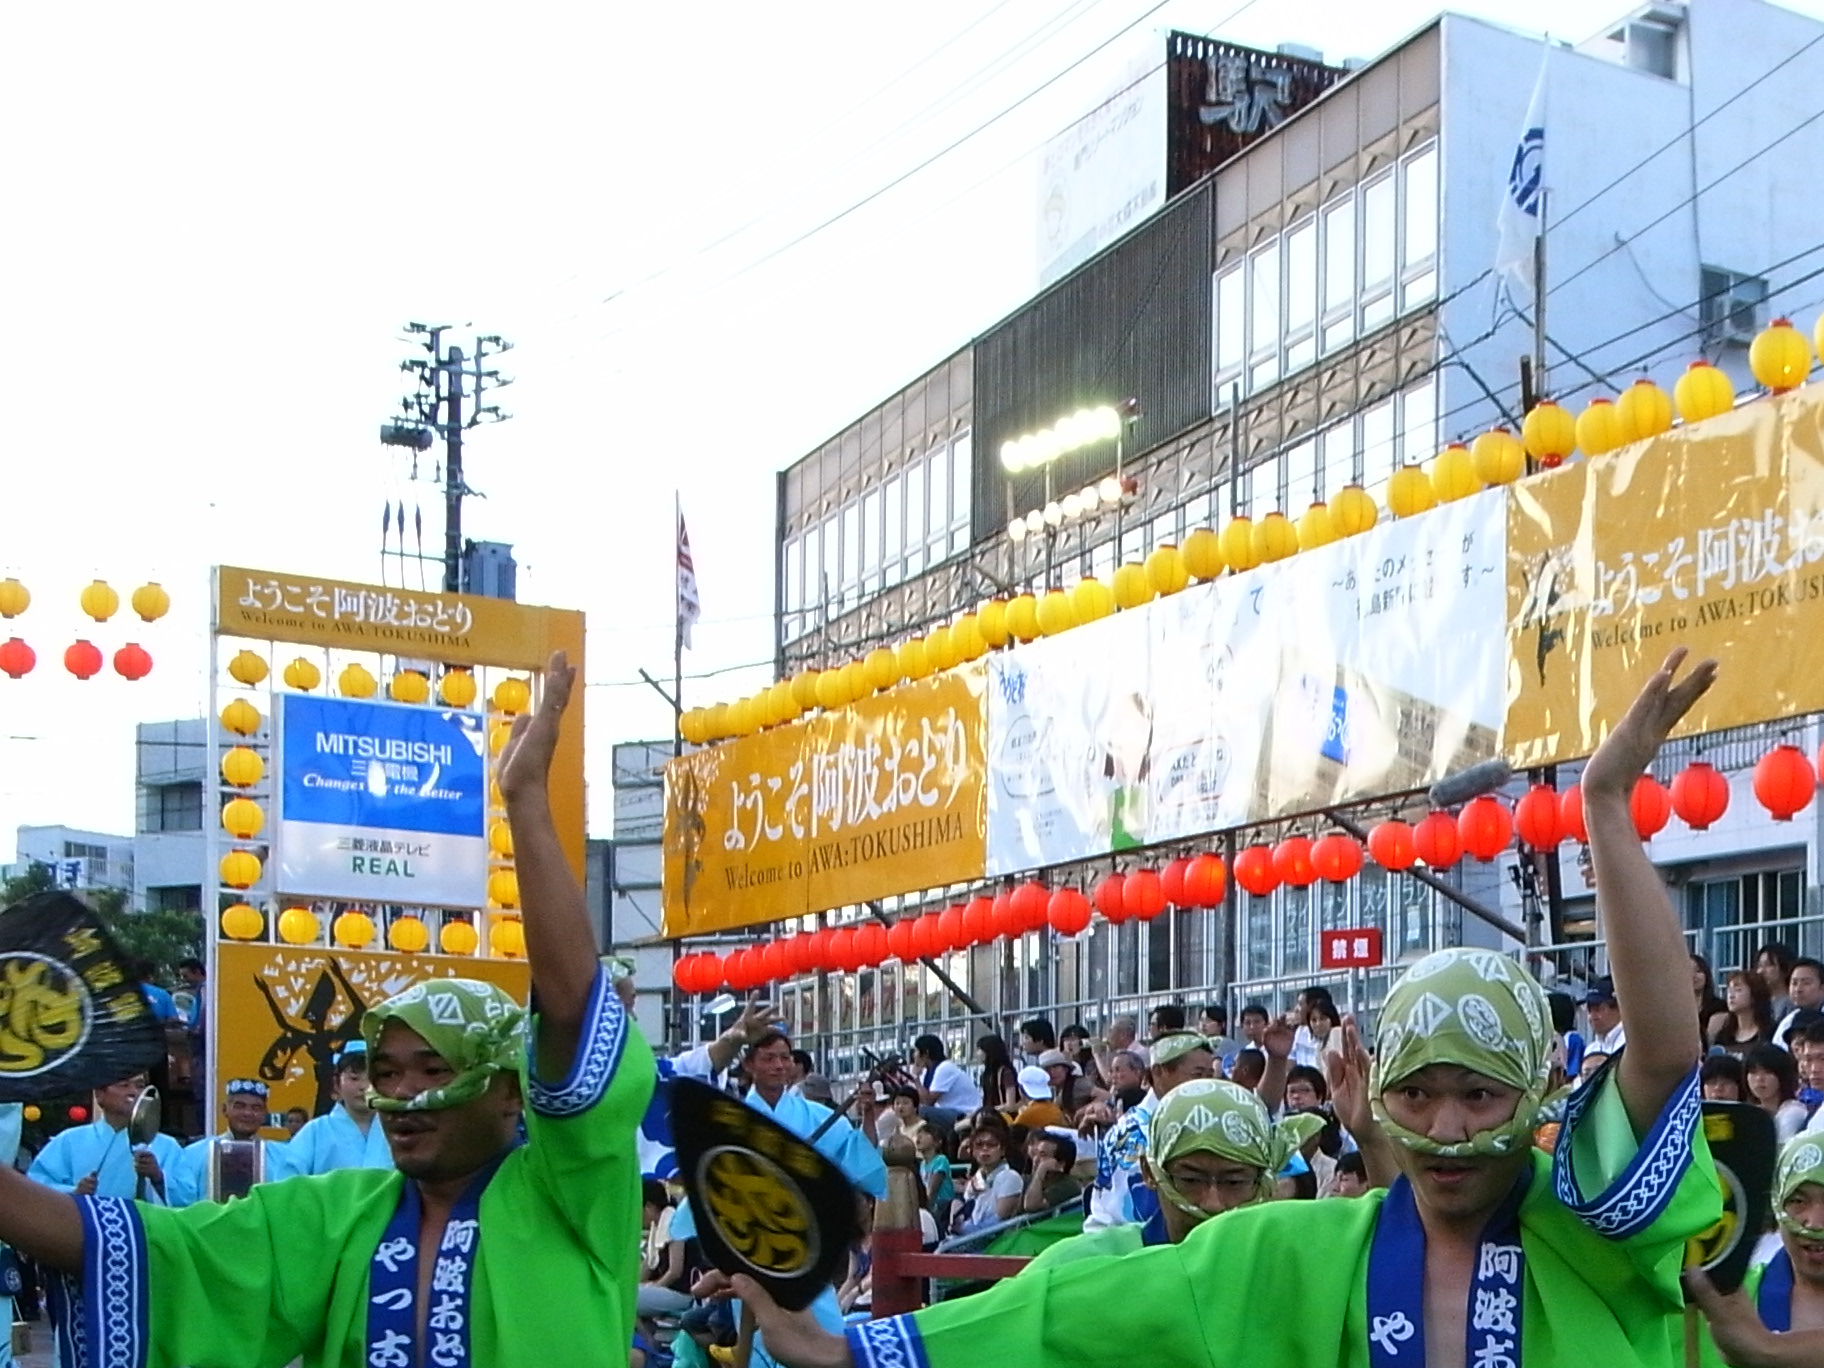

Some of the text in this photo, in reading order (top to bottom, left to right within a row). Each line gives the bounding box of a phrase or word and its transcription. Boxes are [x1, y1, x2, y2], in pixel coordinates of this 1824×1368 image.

[239, 578, 473, 636] ようこそ阿波おどり
[241, 610, 305, 629] Welcome
[311, 620, 326, 632] to
[1591, 624, 1663, 651] Welcome
[1670, 617, 1688, 636] to
[316, 732, 453, 766] MITSUBISHI
[303, 773, 365, 791] Changes
[394, 783, 415, 797] the
[351, 759, 419, 781] 三電機
[724, 707, 967, 851] ようこそ阿波おどり
[352, 856, 416, 878] REAL
[725, 862, 783, 891] Welcome
[788, 858, 803, 881] to
